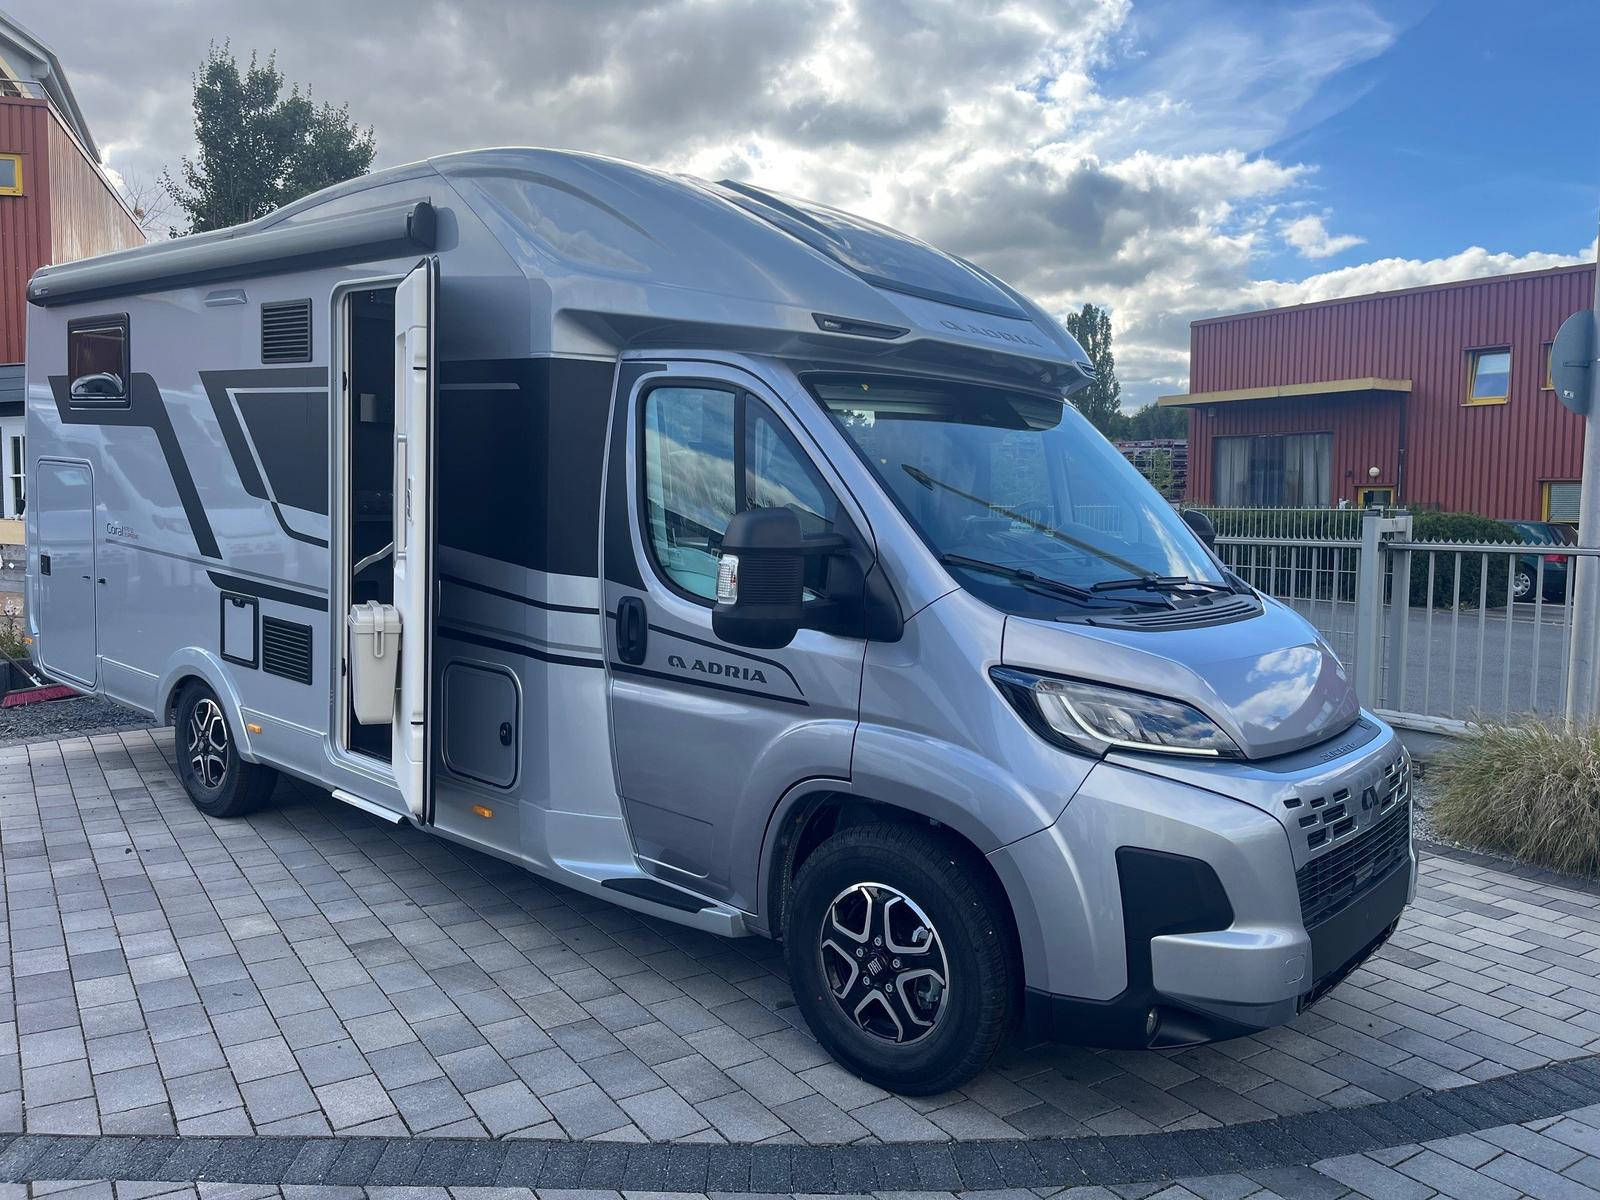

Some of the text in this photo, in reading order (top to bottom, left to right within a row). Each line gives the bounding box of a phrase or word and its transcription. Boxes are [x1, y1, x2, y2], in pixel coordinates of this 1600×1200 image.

[967, 324, 1042, 347] ADRIA
[106, 523, 124, 536] Coral
[691, 659, 768, 684] ADRIA
[867, 957, 883, 976] FIAT
